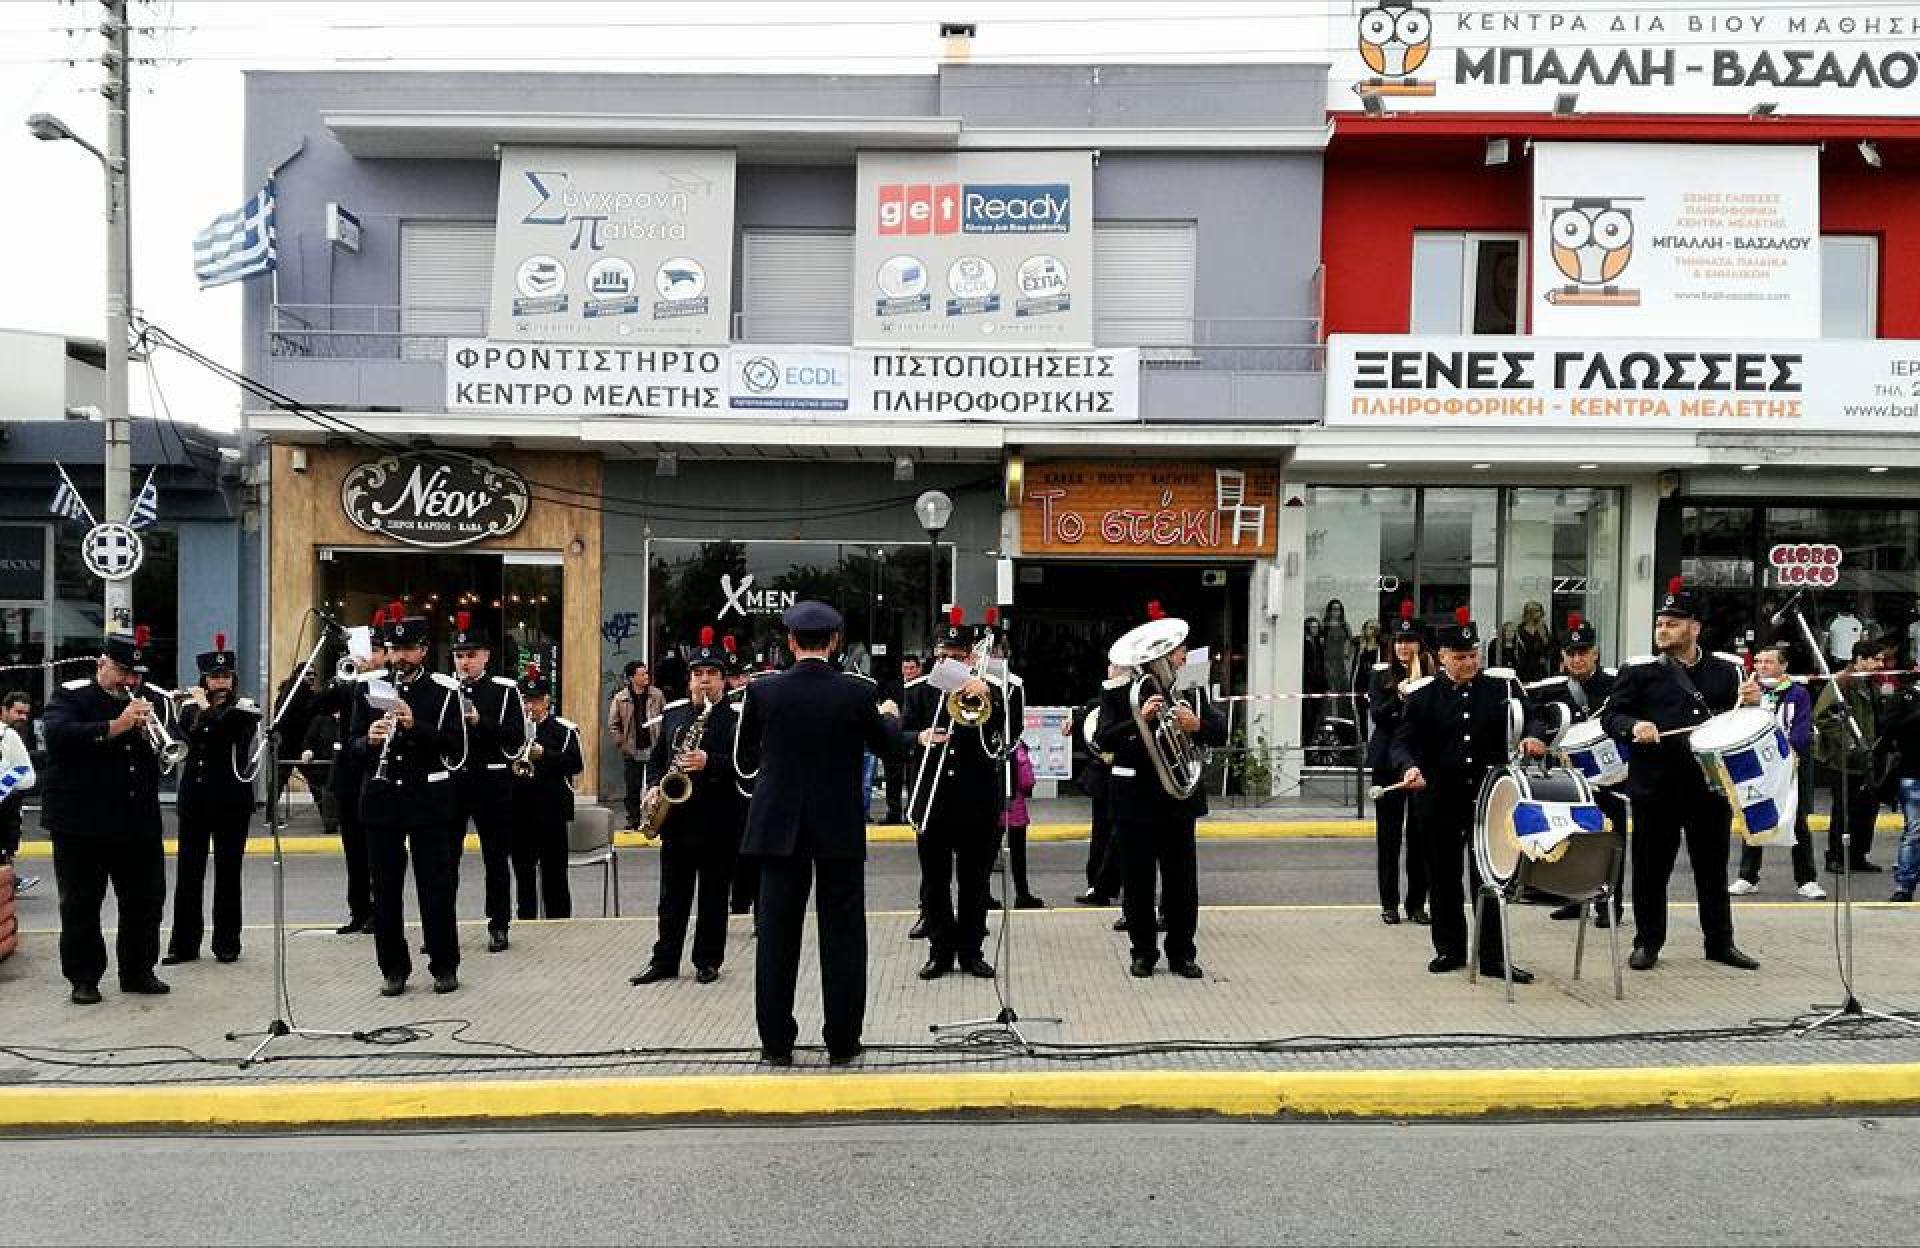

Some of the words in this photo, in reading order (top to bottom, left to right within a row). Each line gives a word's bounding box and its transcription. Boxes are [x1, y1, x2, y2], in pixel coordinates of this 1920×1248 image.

[1457, 13, 1587, 31] ΚΕΝΤΡΑ
[1610, 14, 1665, 32] ΔΙΑ
[1688, 15, 1765, 32] ΒΙΟΥ
[1455, 48, 1675, 86] ΜΠΑΛΛΗ
[1713, 49, 1920, 89] ΒΑΣΑΛΟ
[881, 197, 955, 227] get
[965, 193, 1069, 225] Ready
[1652, 236, 1723, 249] ΜΠΑΛΛΗ
[1733, 236, 1811, 250] ΒΑΣΑΛΟΥ
[455, 347, 720, 373] ΦΡΟΝΤΙΣΤΗΡΙΟ
[873, 355, 1115, 378] ΠΙΣΤΟΠΟΙΗΣΕΙΣ
[1354, 351, 1535, 389] ΞΕΝΕΣ
[1553, 351, 1803, 392] ΓΛΩΣΣΕΣ
[785, 367, 842, 386] ECDL
[457, 383, 573, 405] ΚΕΝΤΡΟ
[583, 385, 720, 409] ΜΕΛΕΤΗΣ
[873, 389, 1115, 413] ΠΛΗΡΟΦΟΡΙΚΗΣ
[1351, 397, 1544, 416] ΠΛΗΡΟΦΟΡΙΚΗ
[1570, 398, 1670, 417] ΚΕΝΤΡΑ
[1679, 399, 1803, 418] ΜΕΛΕΤΗΣ
[371, 463, 492, 518] Νέον
[1029, 490, 1085, 545] Το
[1777, 564, 1839, 587] LOCO
